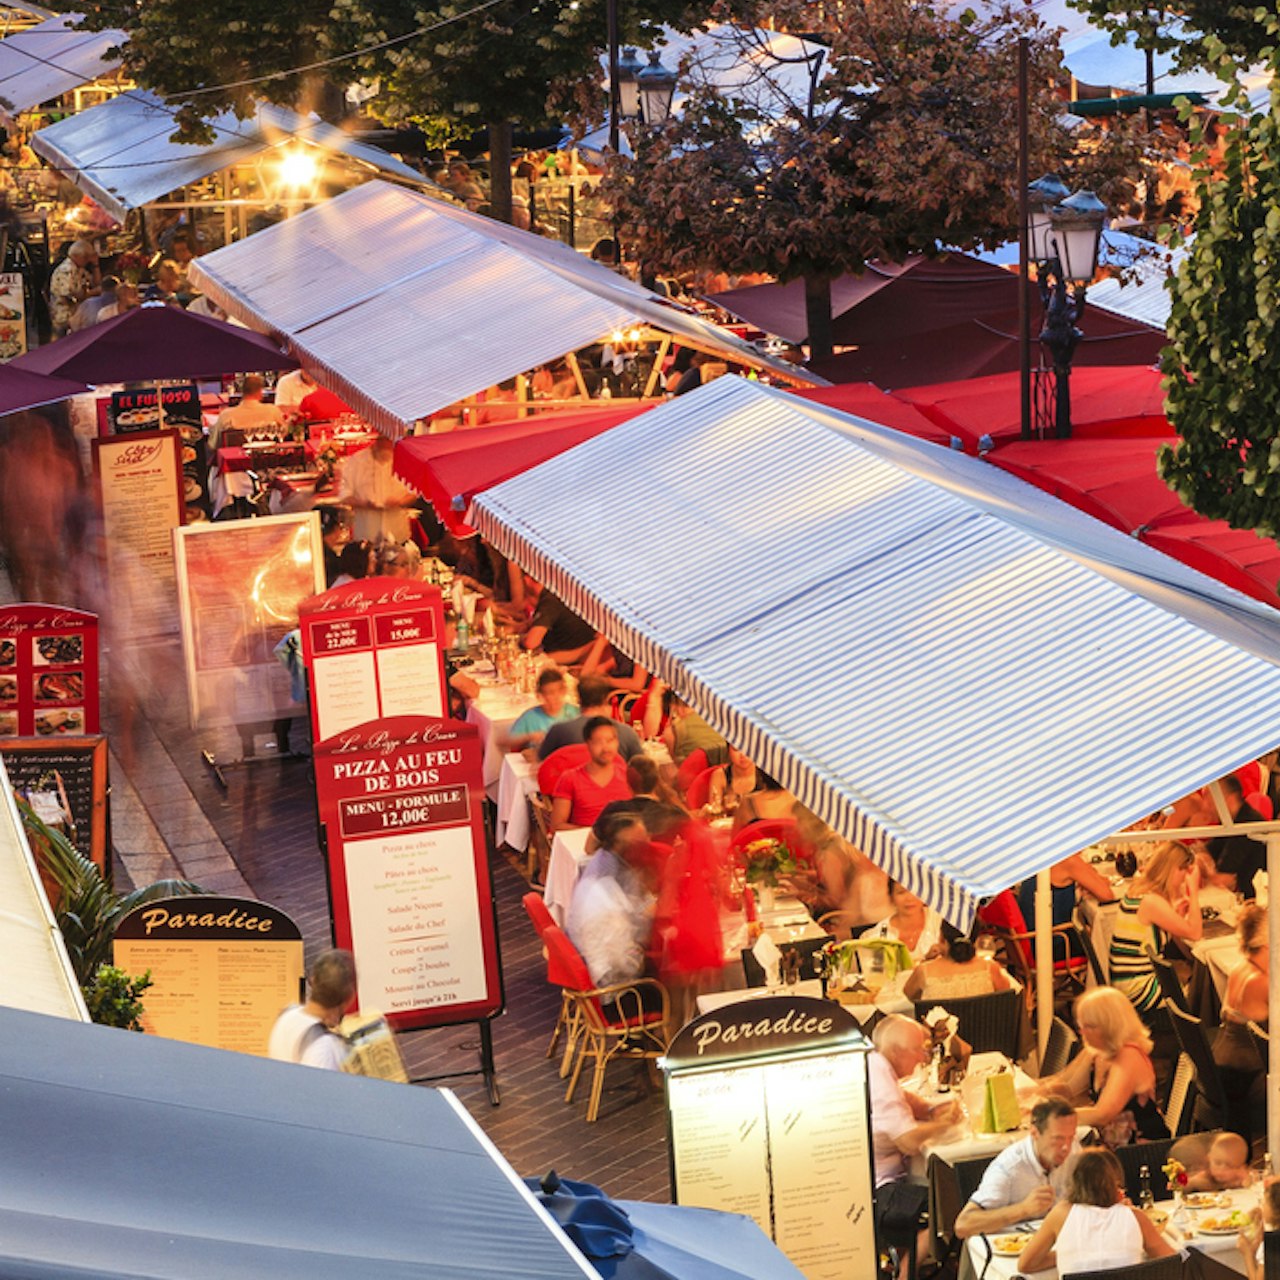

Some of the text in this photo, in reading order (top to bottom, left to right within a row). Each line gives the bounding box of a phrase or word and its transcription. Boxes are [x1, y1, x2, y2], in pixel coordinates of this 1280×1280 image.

[118, 394, 134, 408] EL
[333, 748, 462, 779] PIZZA AU FEU
[365, 768, 440, 793] DE BOIS
[346, 800, 386, 816] MENU
[395, 790, 461, 810] FORMULE
[381, 807, 430, 827] 12,00€
[141, 908, 273, 935] Paradice
[692, 1008, 833, 1055] Paradice
